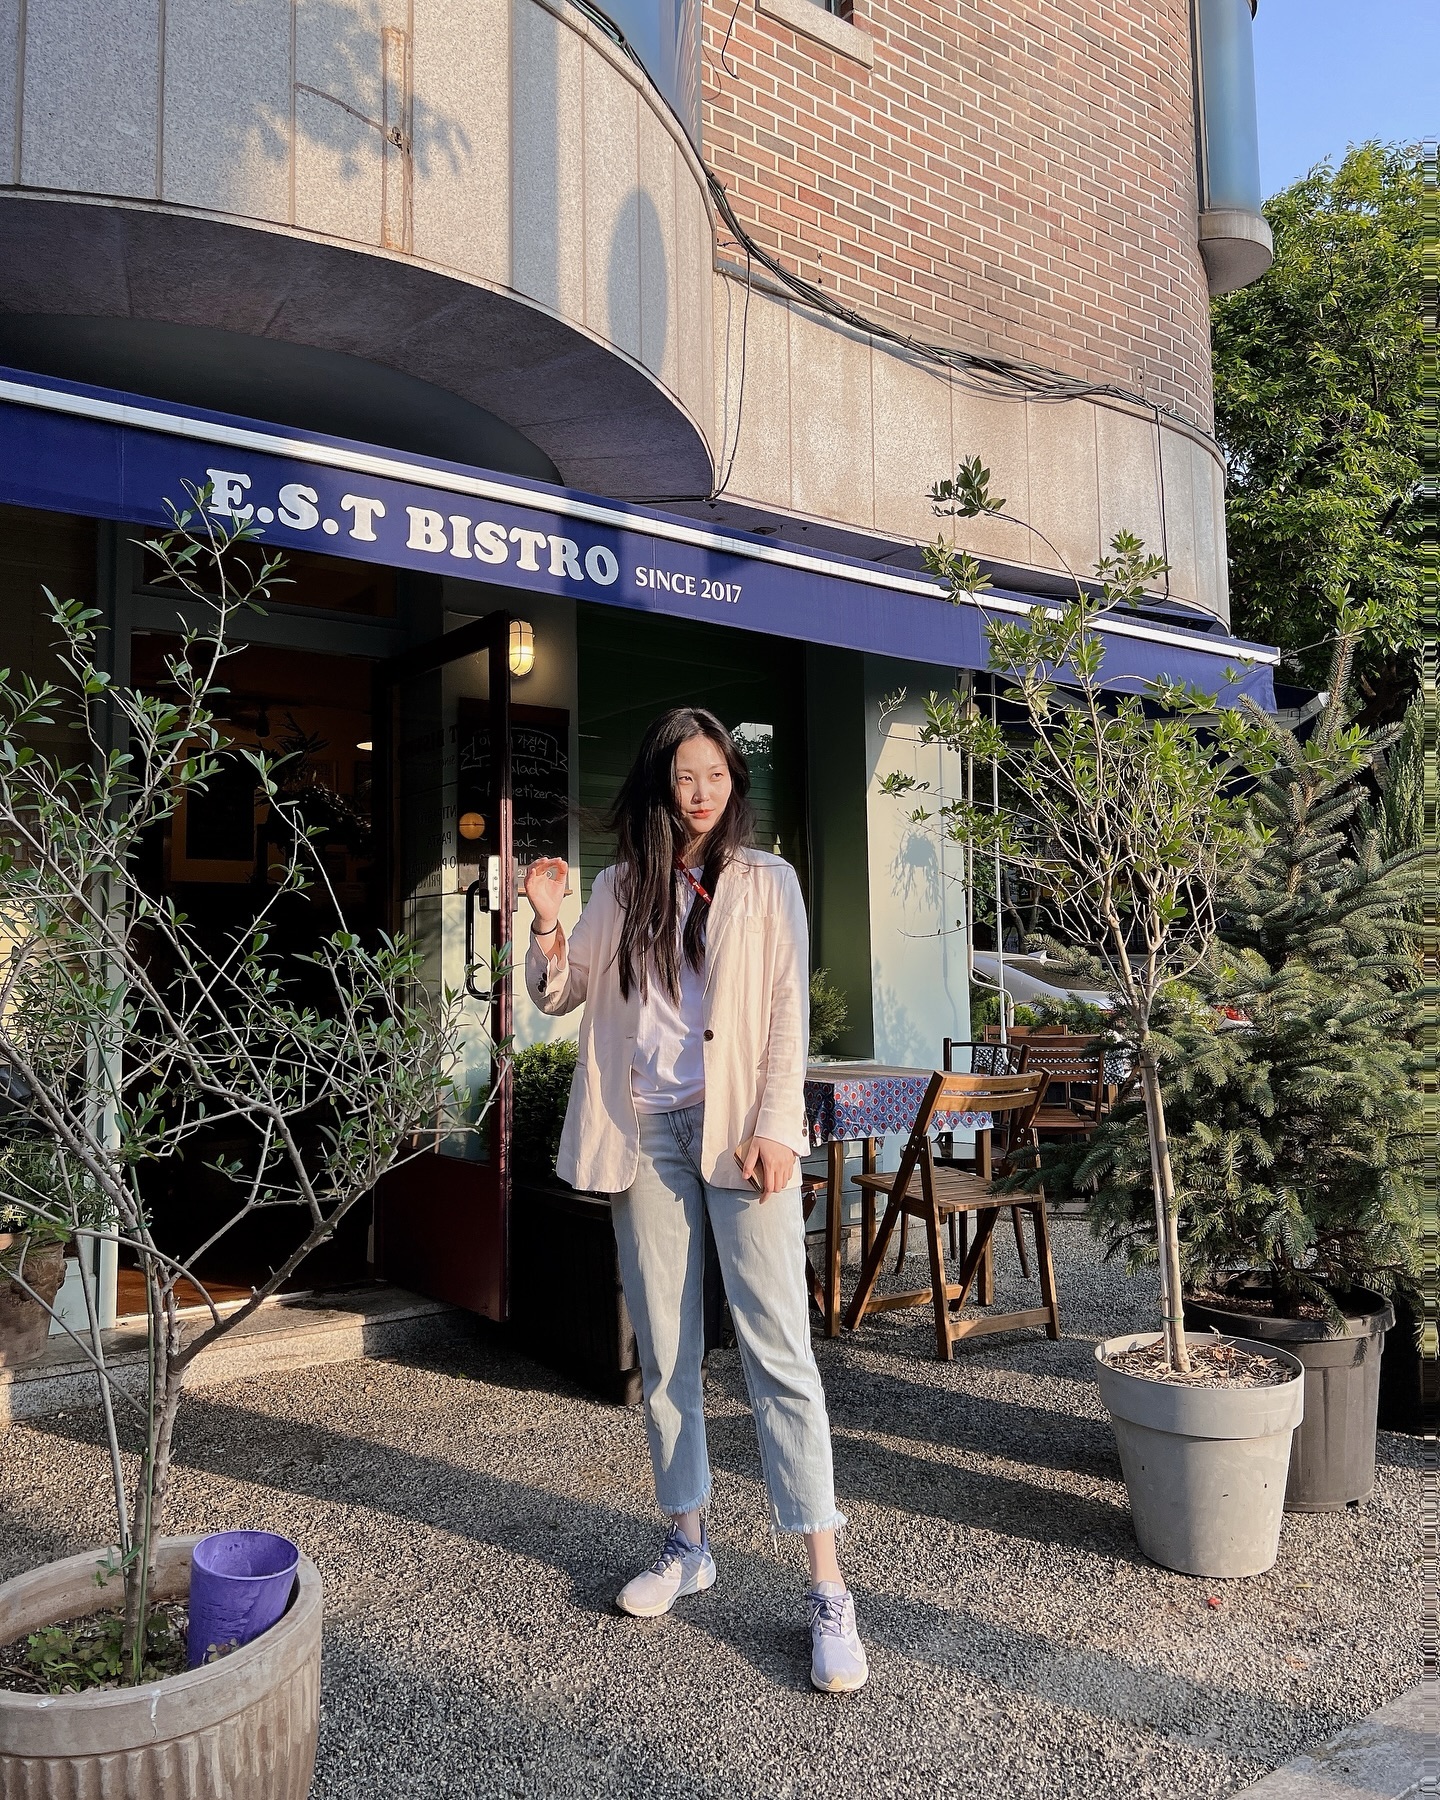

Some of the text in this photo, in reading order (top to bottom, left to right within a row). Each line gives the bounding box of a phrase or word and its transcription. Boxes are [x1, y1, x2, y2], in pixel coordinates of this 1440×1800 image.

[206, 468, 620, 586] E.S.T BISTRO
[635, 566, 742, 604] SINCE 2017
